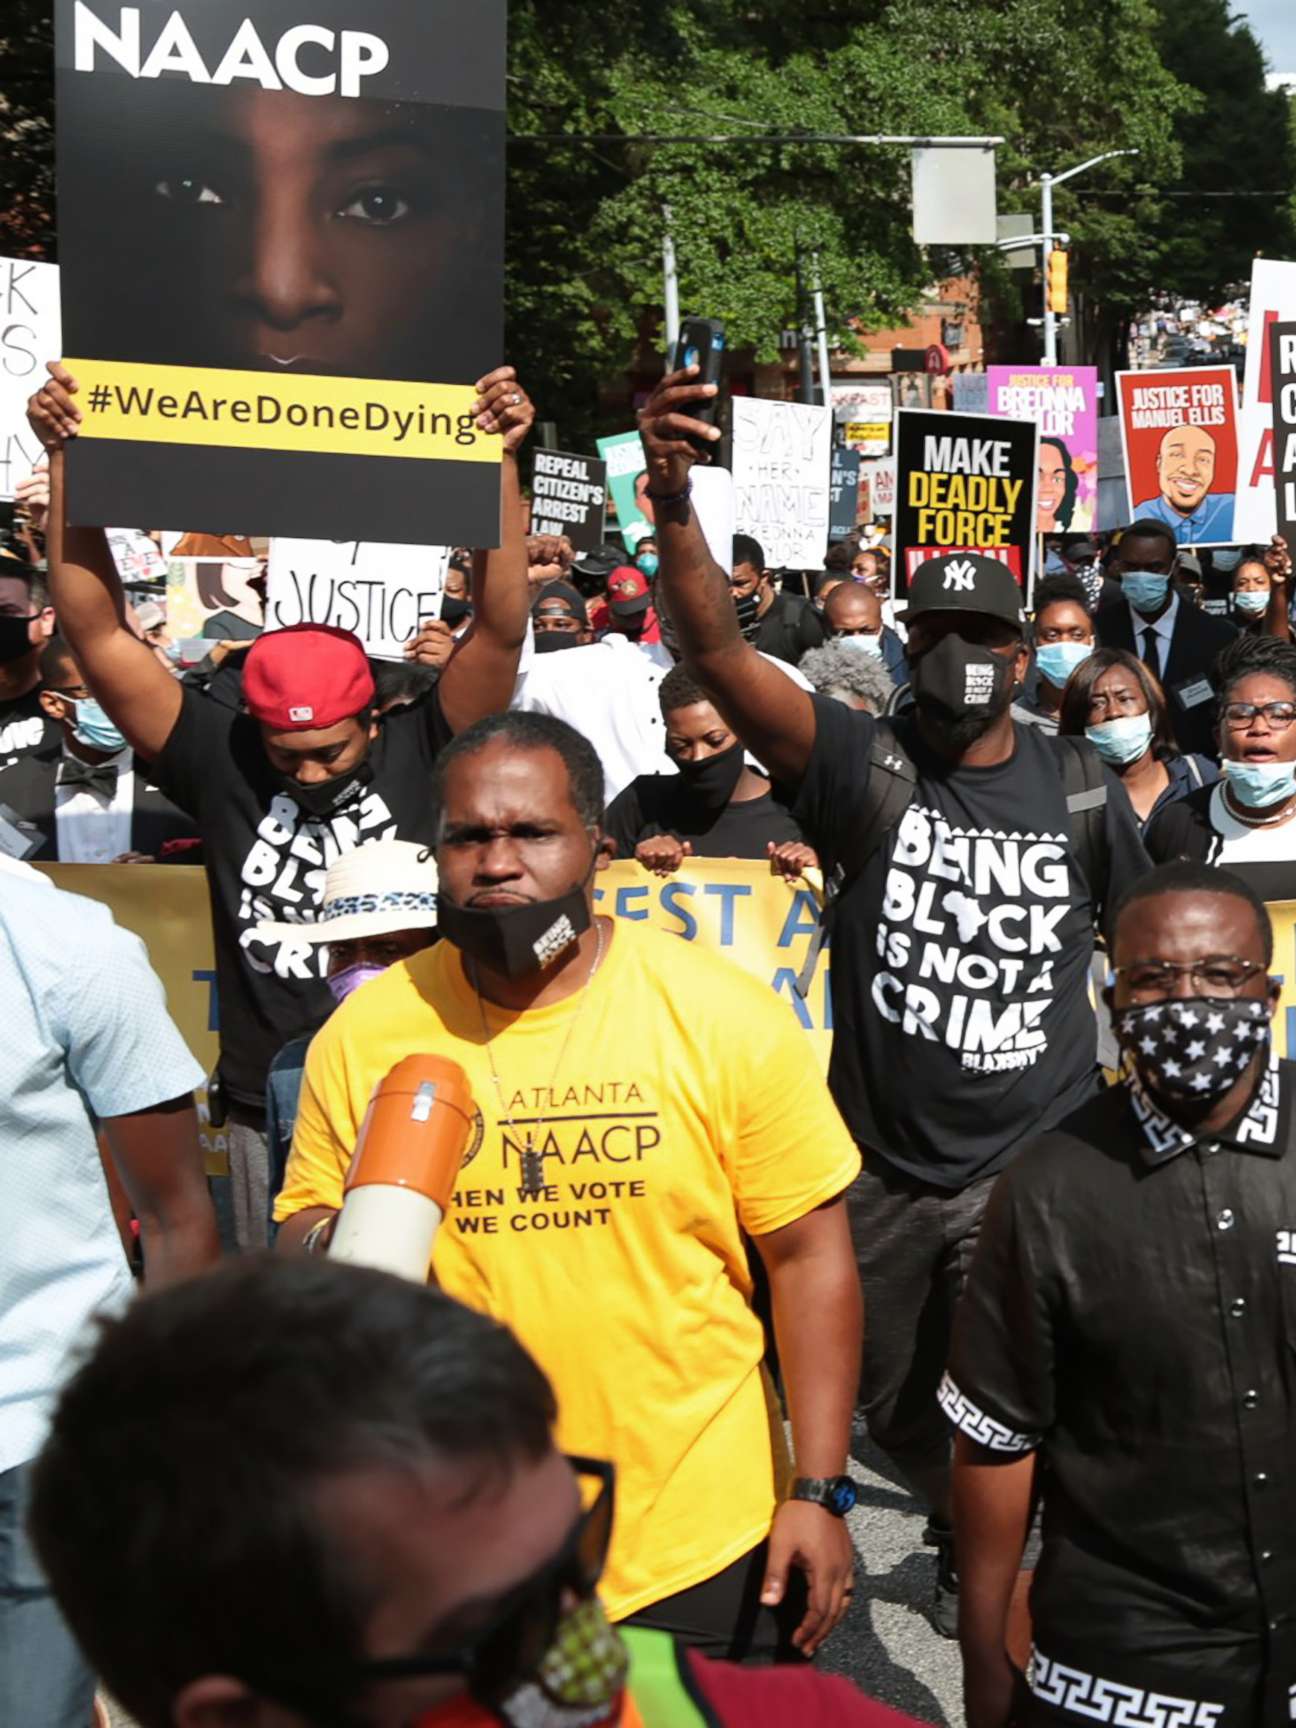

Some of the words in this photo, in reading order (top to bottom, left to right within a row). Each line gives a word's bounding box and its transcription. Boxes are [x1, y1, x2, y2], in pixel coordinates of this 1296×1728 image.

[74, 1, 390, 98] NAACP
[88, 383, 477, 444] #WeAreDoneDying
[997, 386, 1086, 412] BREONNA
[1132, 386, 1189, 410] JUSTICE
[1190, 384, 1225, 407] FOR
[1189, 403, 1225, 427] ELLIS
[534, 453, 590, 482] REPEAL
[923, 435, 1012, 478] MAKE
[532, 476, 605, 506] CITIZEN'S
[532, 498, 588, 524] ARREST
[908, 470, 1024, 514] DEADLY
[918, 508, 1013, 548] FORCE
[275, 570, 437, 642] JUSTICE
[892, 807, 1070, 897] BEING
[876, 923, 911, 968] IS
[919, 942, 1024, 995] NOT
[1027, 960, 1054, 994] A
[871, 971, 1053, 1051] CRIME
[509, 1082, 644, 1110] ATLANTA
[501, 1125, 662, 1170] NAACP
[570, 1180, 645, 1200] VOTE
[456, 1216, 498, 1235] WE
[510, 1209, 612, 1233] COUNT
